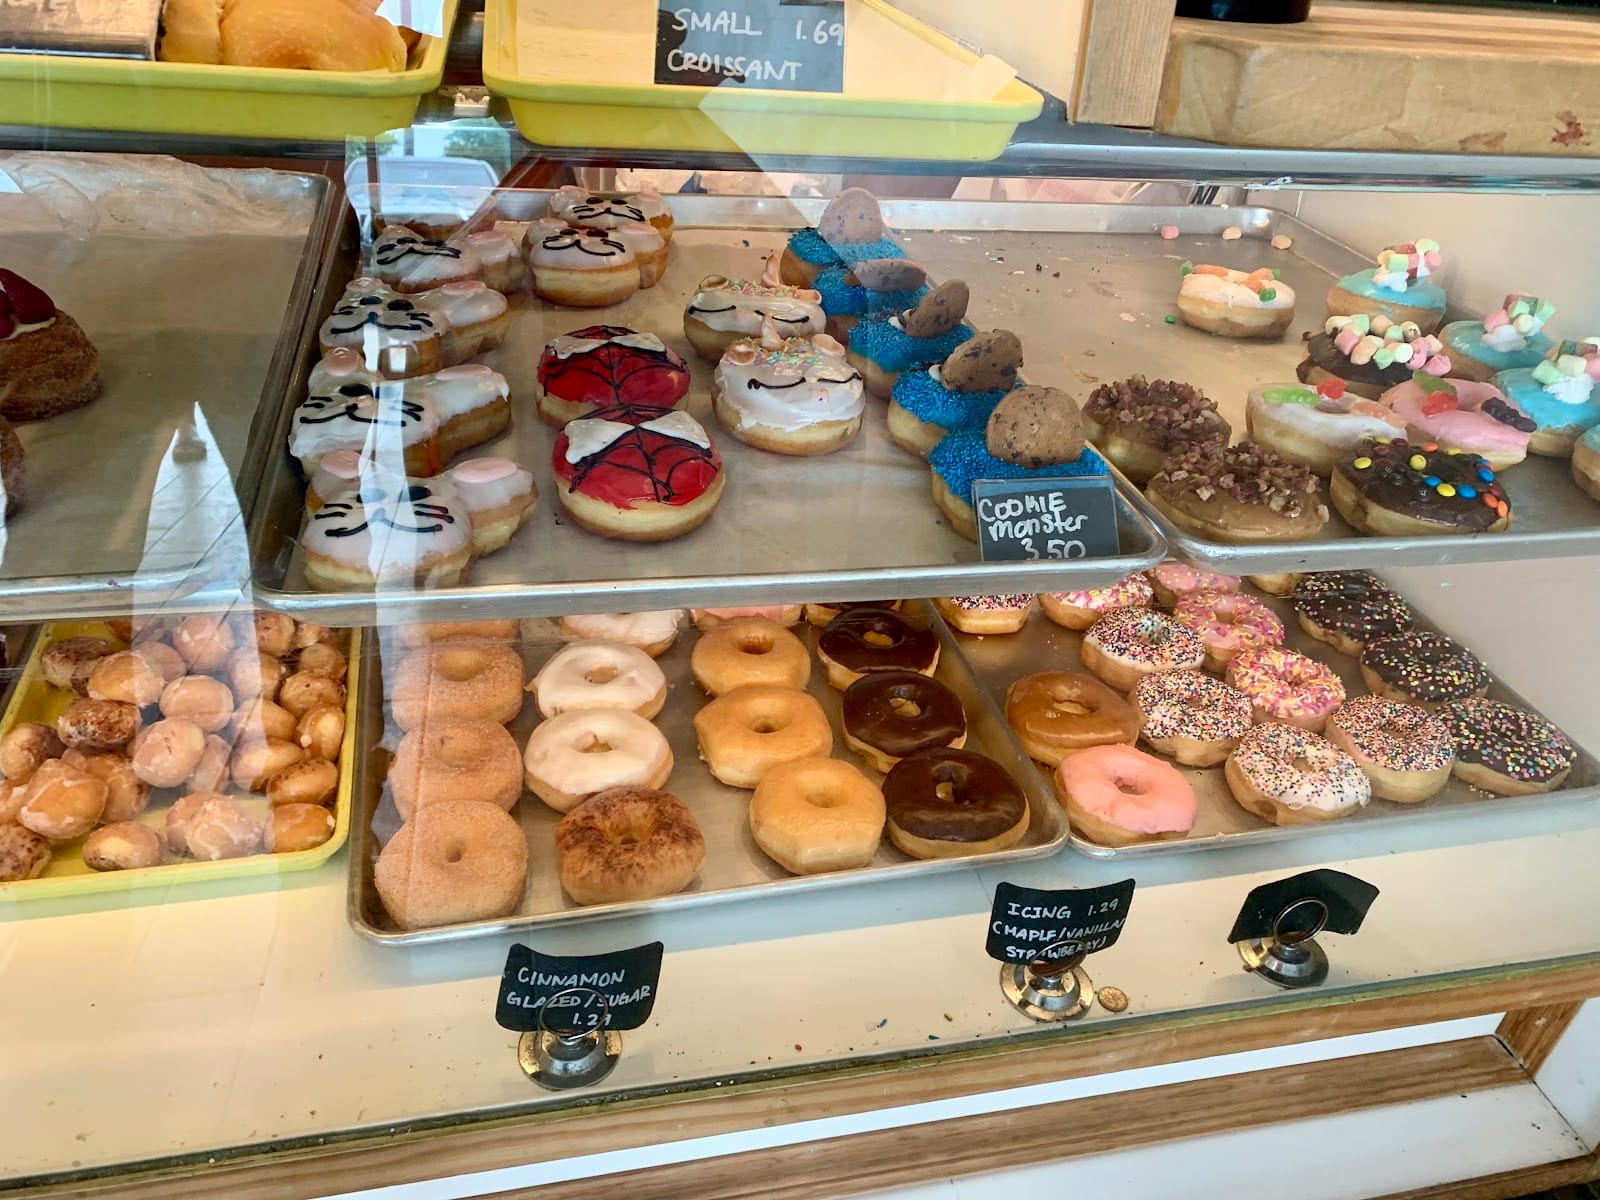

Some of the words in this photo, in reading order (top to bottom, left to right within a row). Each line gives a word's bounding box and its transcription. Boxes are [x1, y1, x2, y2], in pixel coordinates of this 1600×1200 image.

[671, 8, 762, 36] SMALL
[795, 19, 845, 46] 1.69
[667, 49, 803, 81] CROISSANT
[1007, 902, 1072, 919] ICING
[1087, 898, 1119, 916] 1.29
[517, 967, 626, 987] CINNAMON
